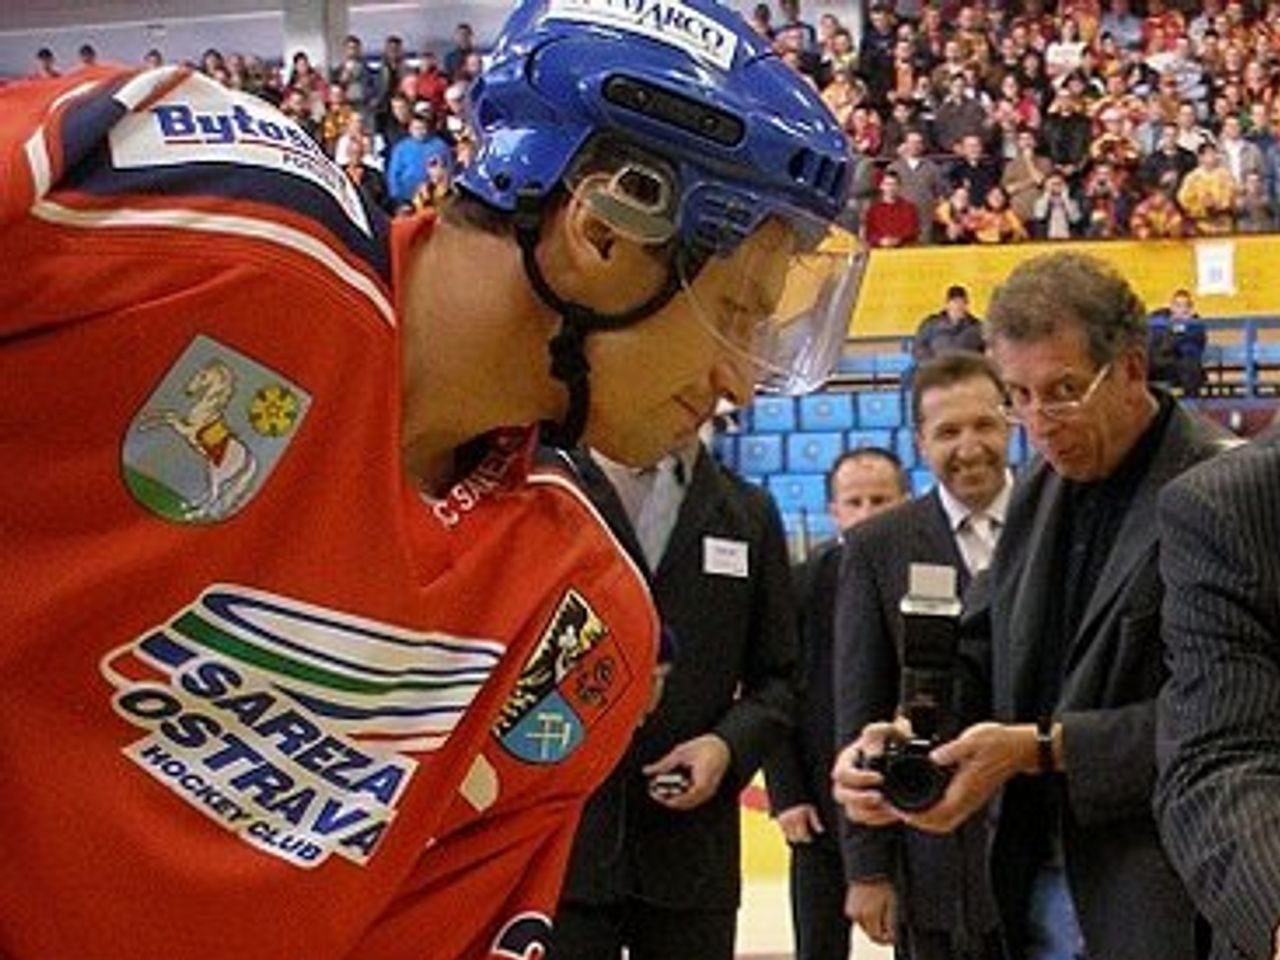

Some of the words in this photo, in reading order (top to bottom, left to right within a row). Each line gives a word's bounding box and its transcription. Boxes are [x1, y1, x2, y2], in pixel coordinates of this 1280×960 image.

[118, 688, 386, 856] OSTRAVA
[139, 744, 249, 823] HOCKEY
[247, 820, 324, 860] CLUB
[181, 661, 405, 805] SAREZA
